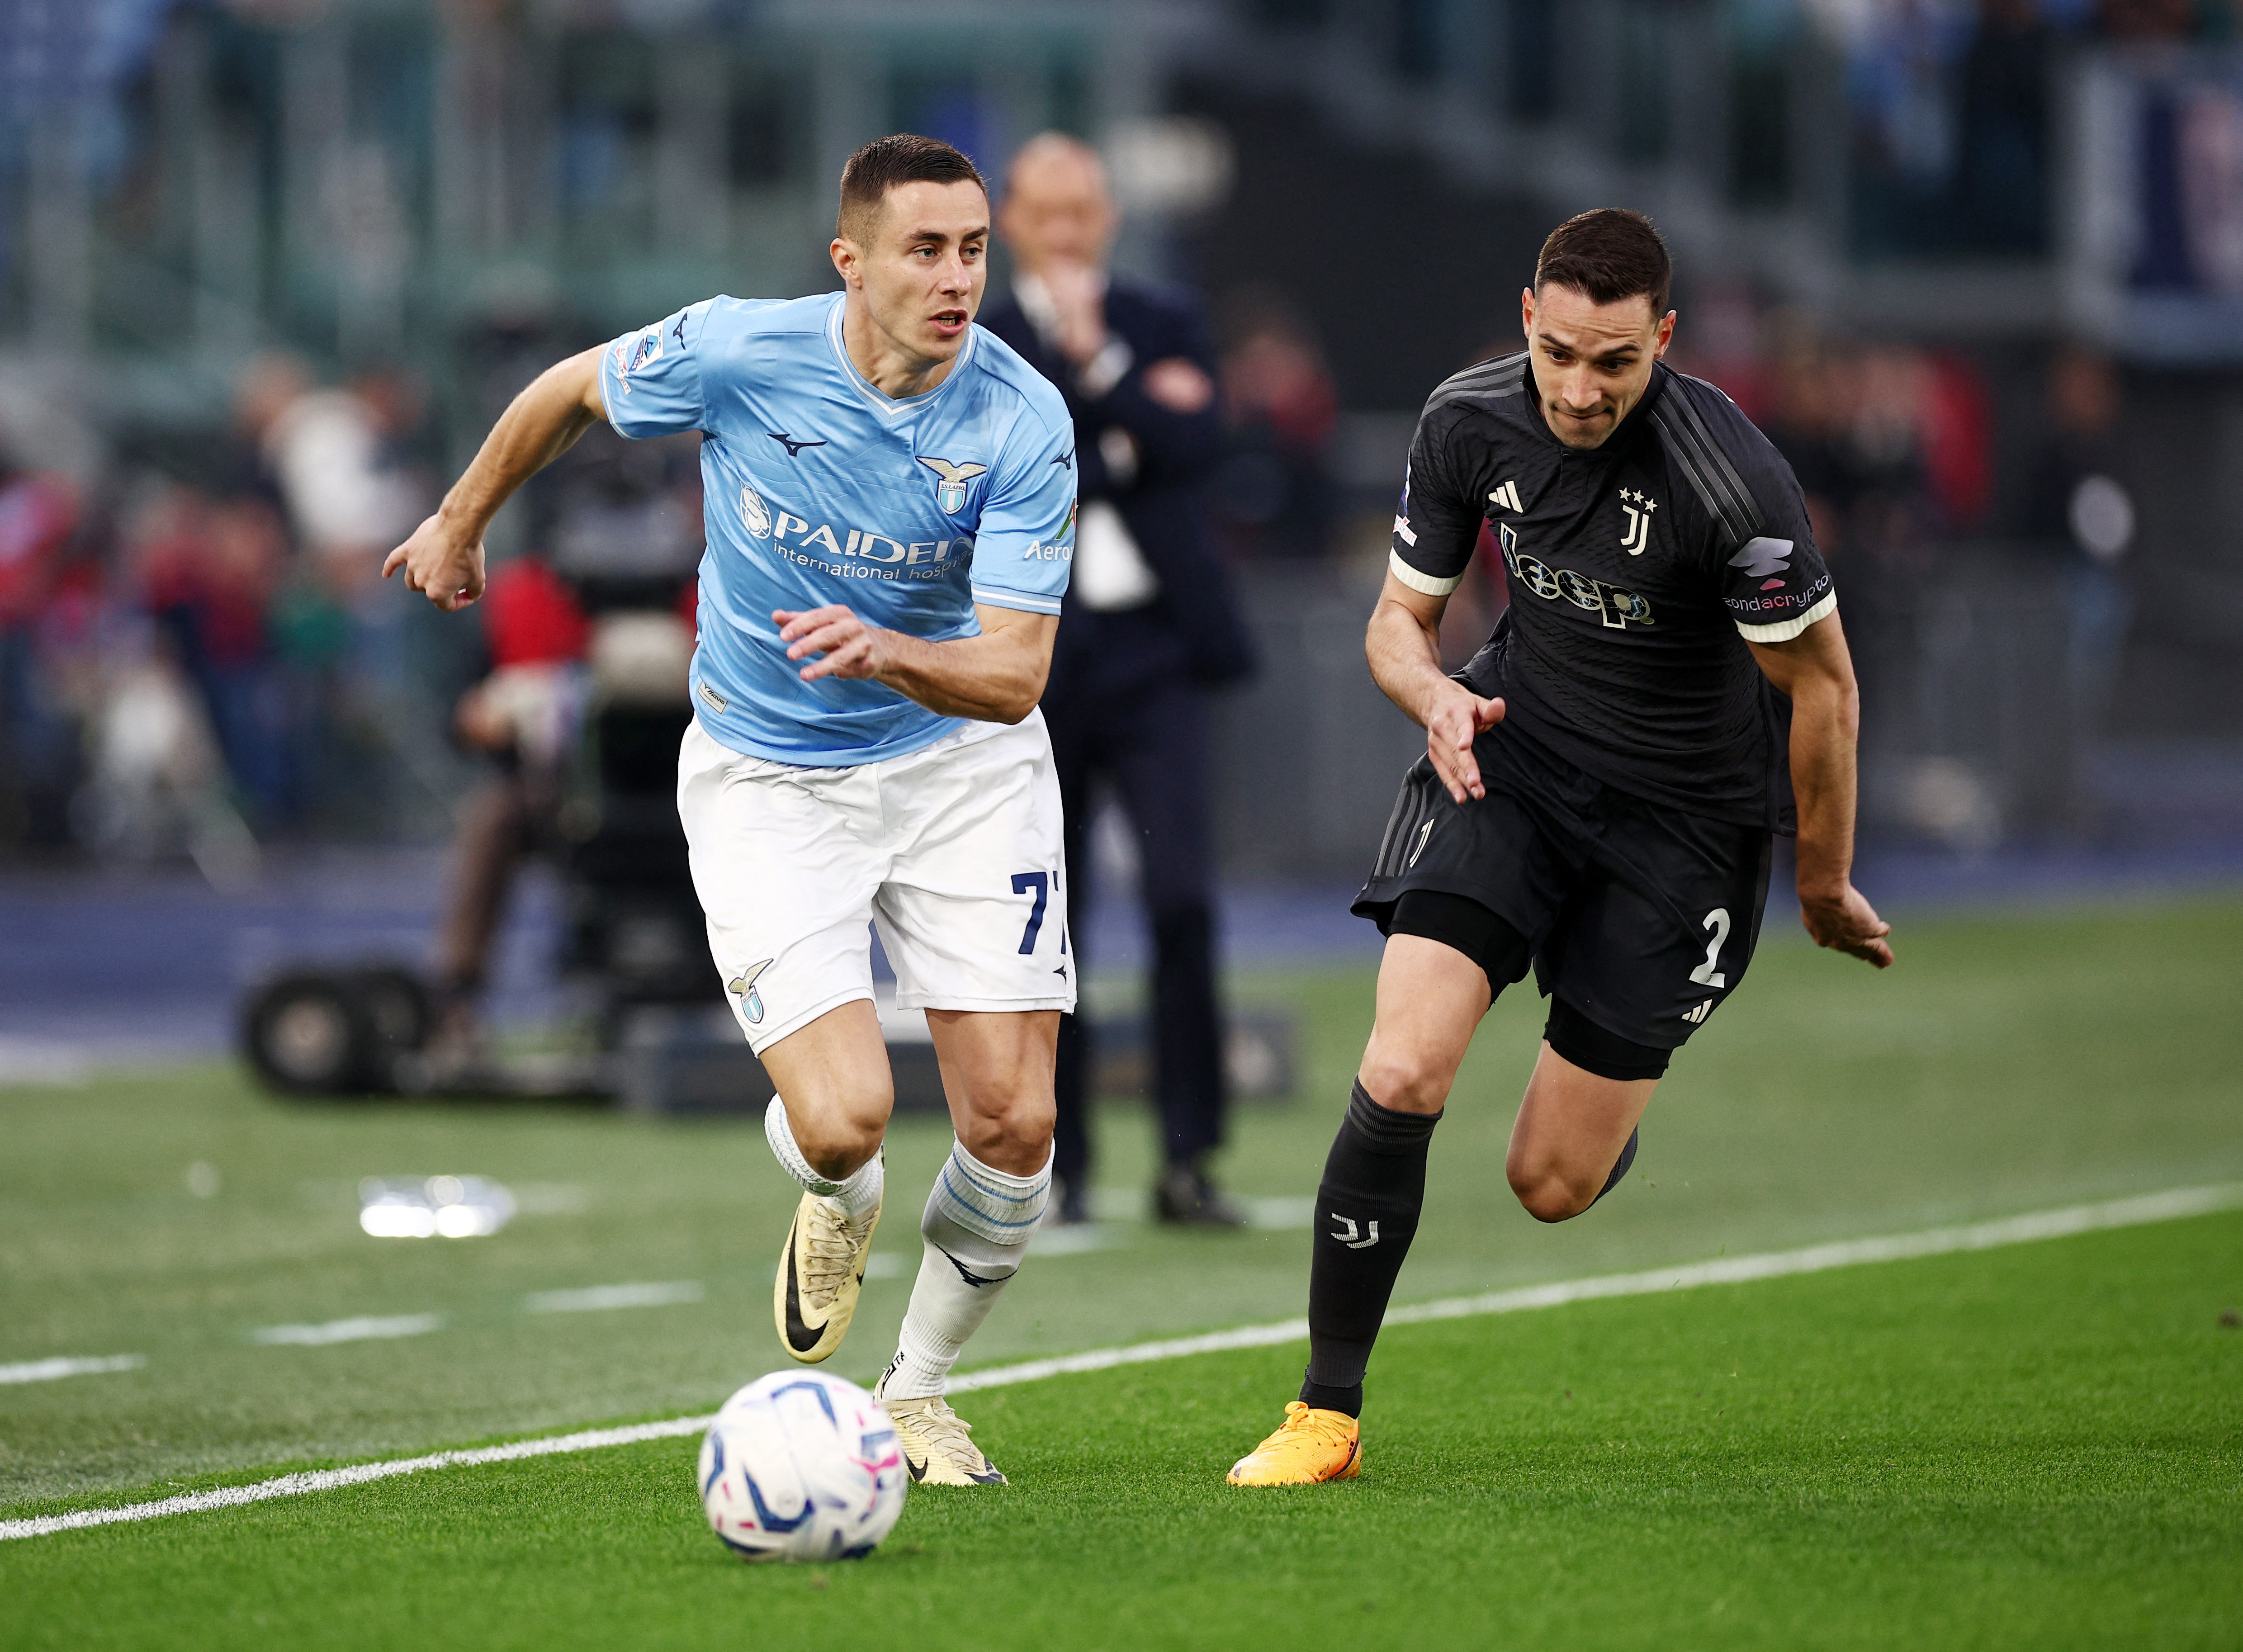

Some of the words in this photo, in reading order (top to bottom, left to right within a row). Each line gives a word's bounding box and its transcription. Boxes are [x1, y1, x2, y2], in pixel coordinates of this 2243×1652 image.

[1405, 530, 1415, 543] OUT
[774, 539, 900, 580] international
[1500, 522, 1650, 629] Jeep
[1722, 575, 1829, 611] zondacrypto
[1689, 908, 1730, 988] 2
